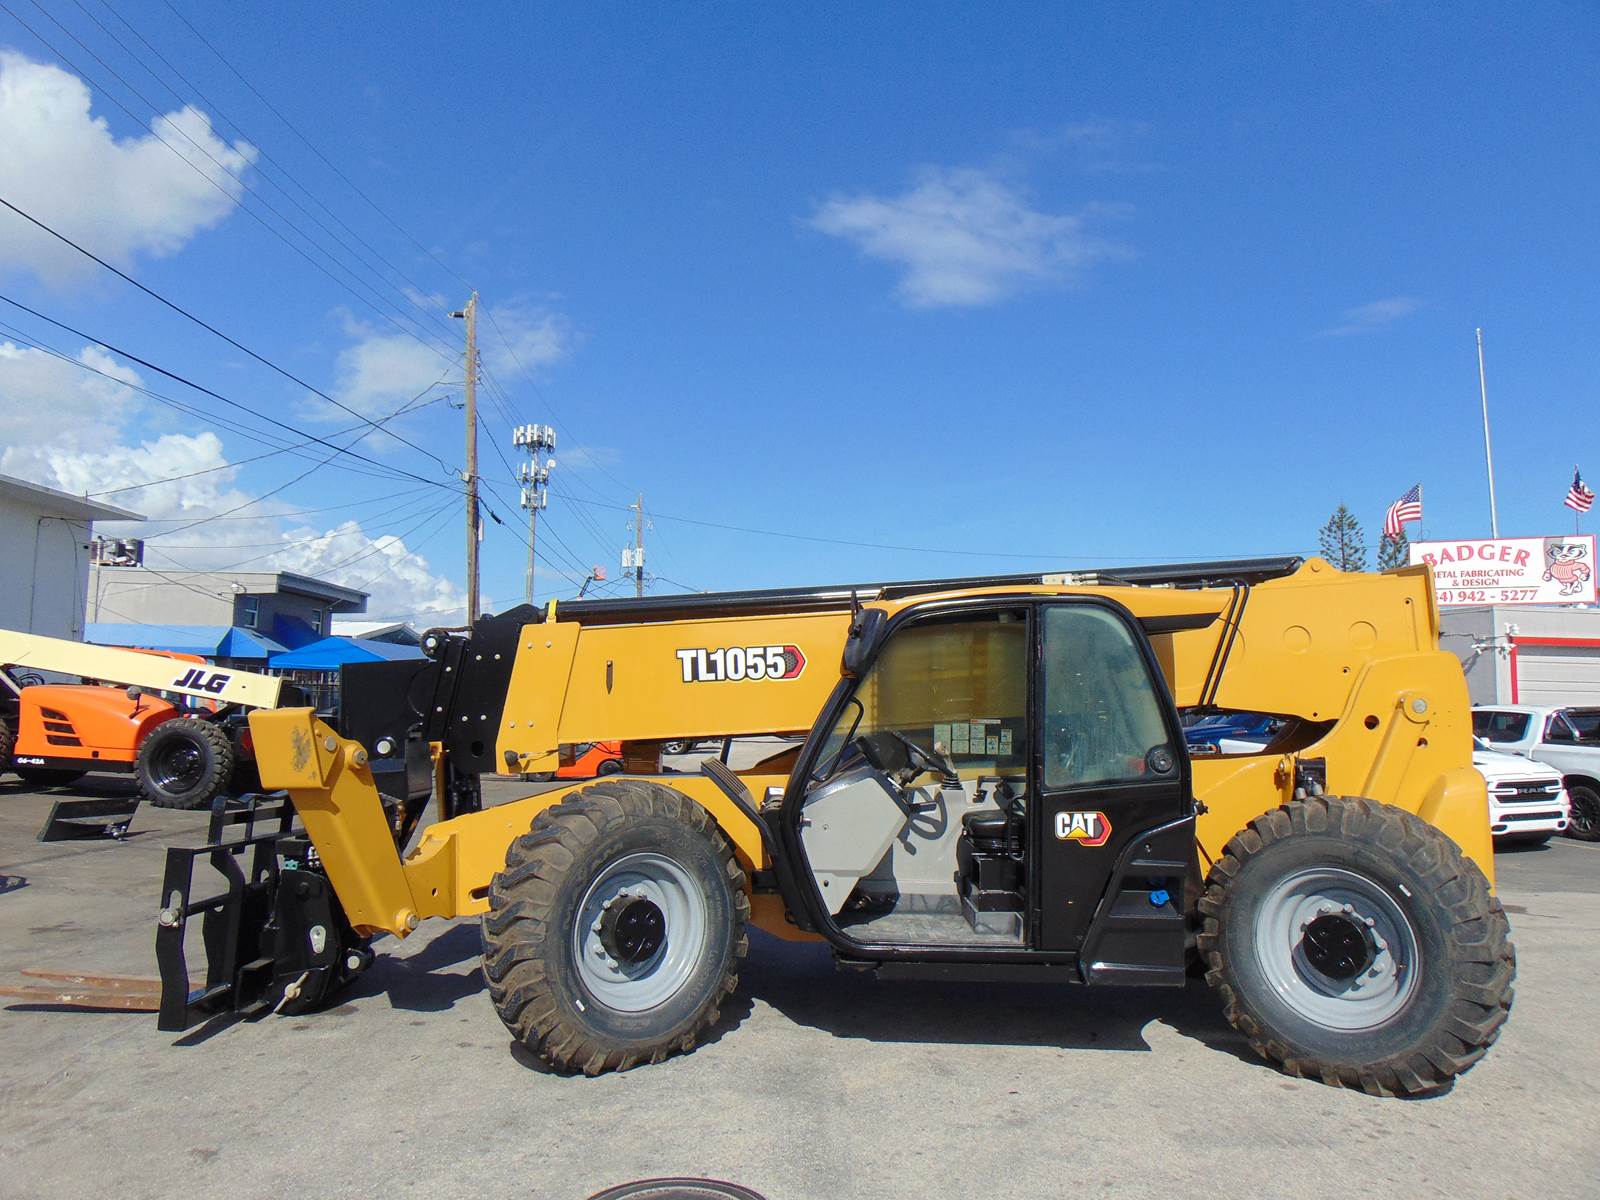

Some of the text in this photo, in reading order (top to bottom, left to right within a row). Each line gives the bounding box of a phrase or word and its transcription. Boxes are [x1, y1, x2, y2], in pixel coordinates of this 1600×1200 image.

[1421, 544, 1531, 568] BADGER
[1460, 568, 1524, 577] FABRICATING
[1462, 578, 1499, 586] DESIGN
[1458, 590, 1486, 602] 942
[1501, 589, 1538, 601] 5277
[676, 646, 786, 683] TL1055
[173, 668, 231, 694] JLG
[1056, 812, 1098, 838] CAT
